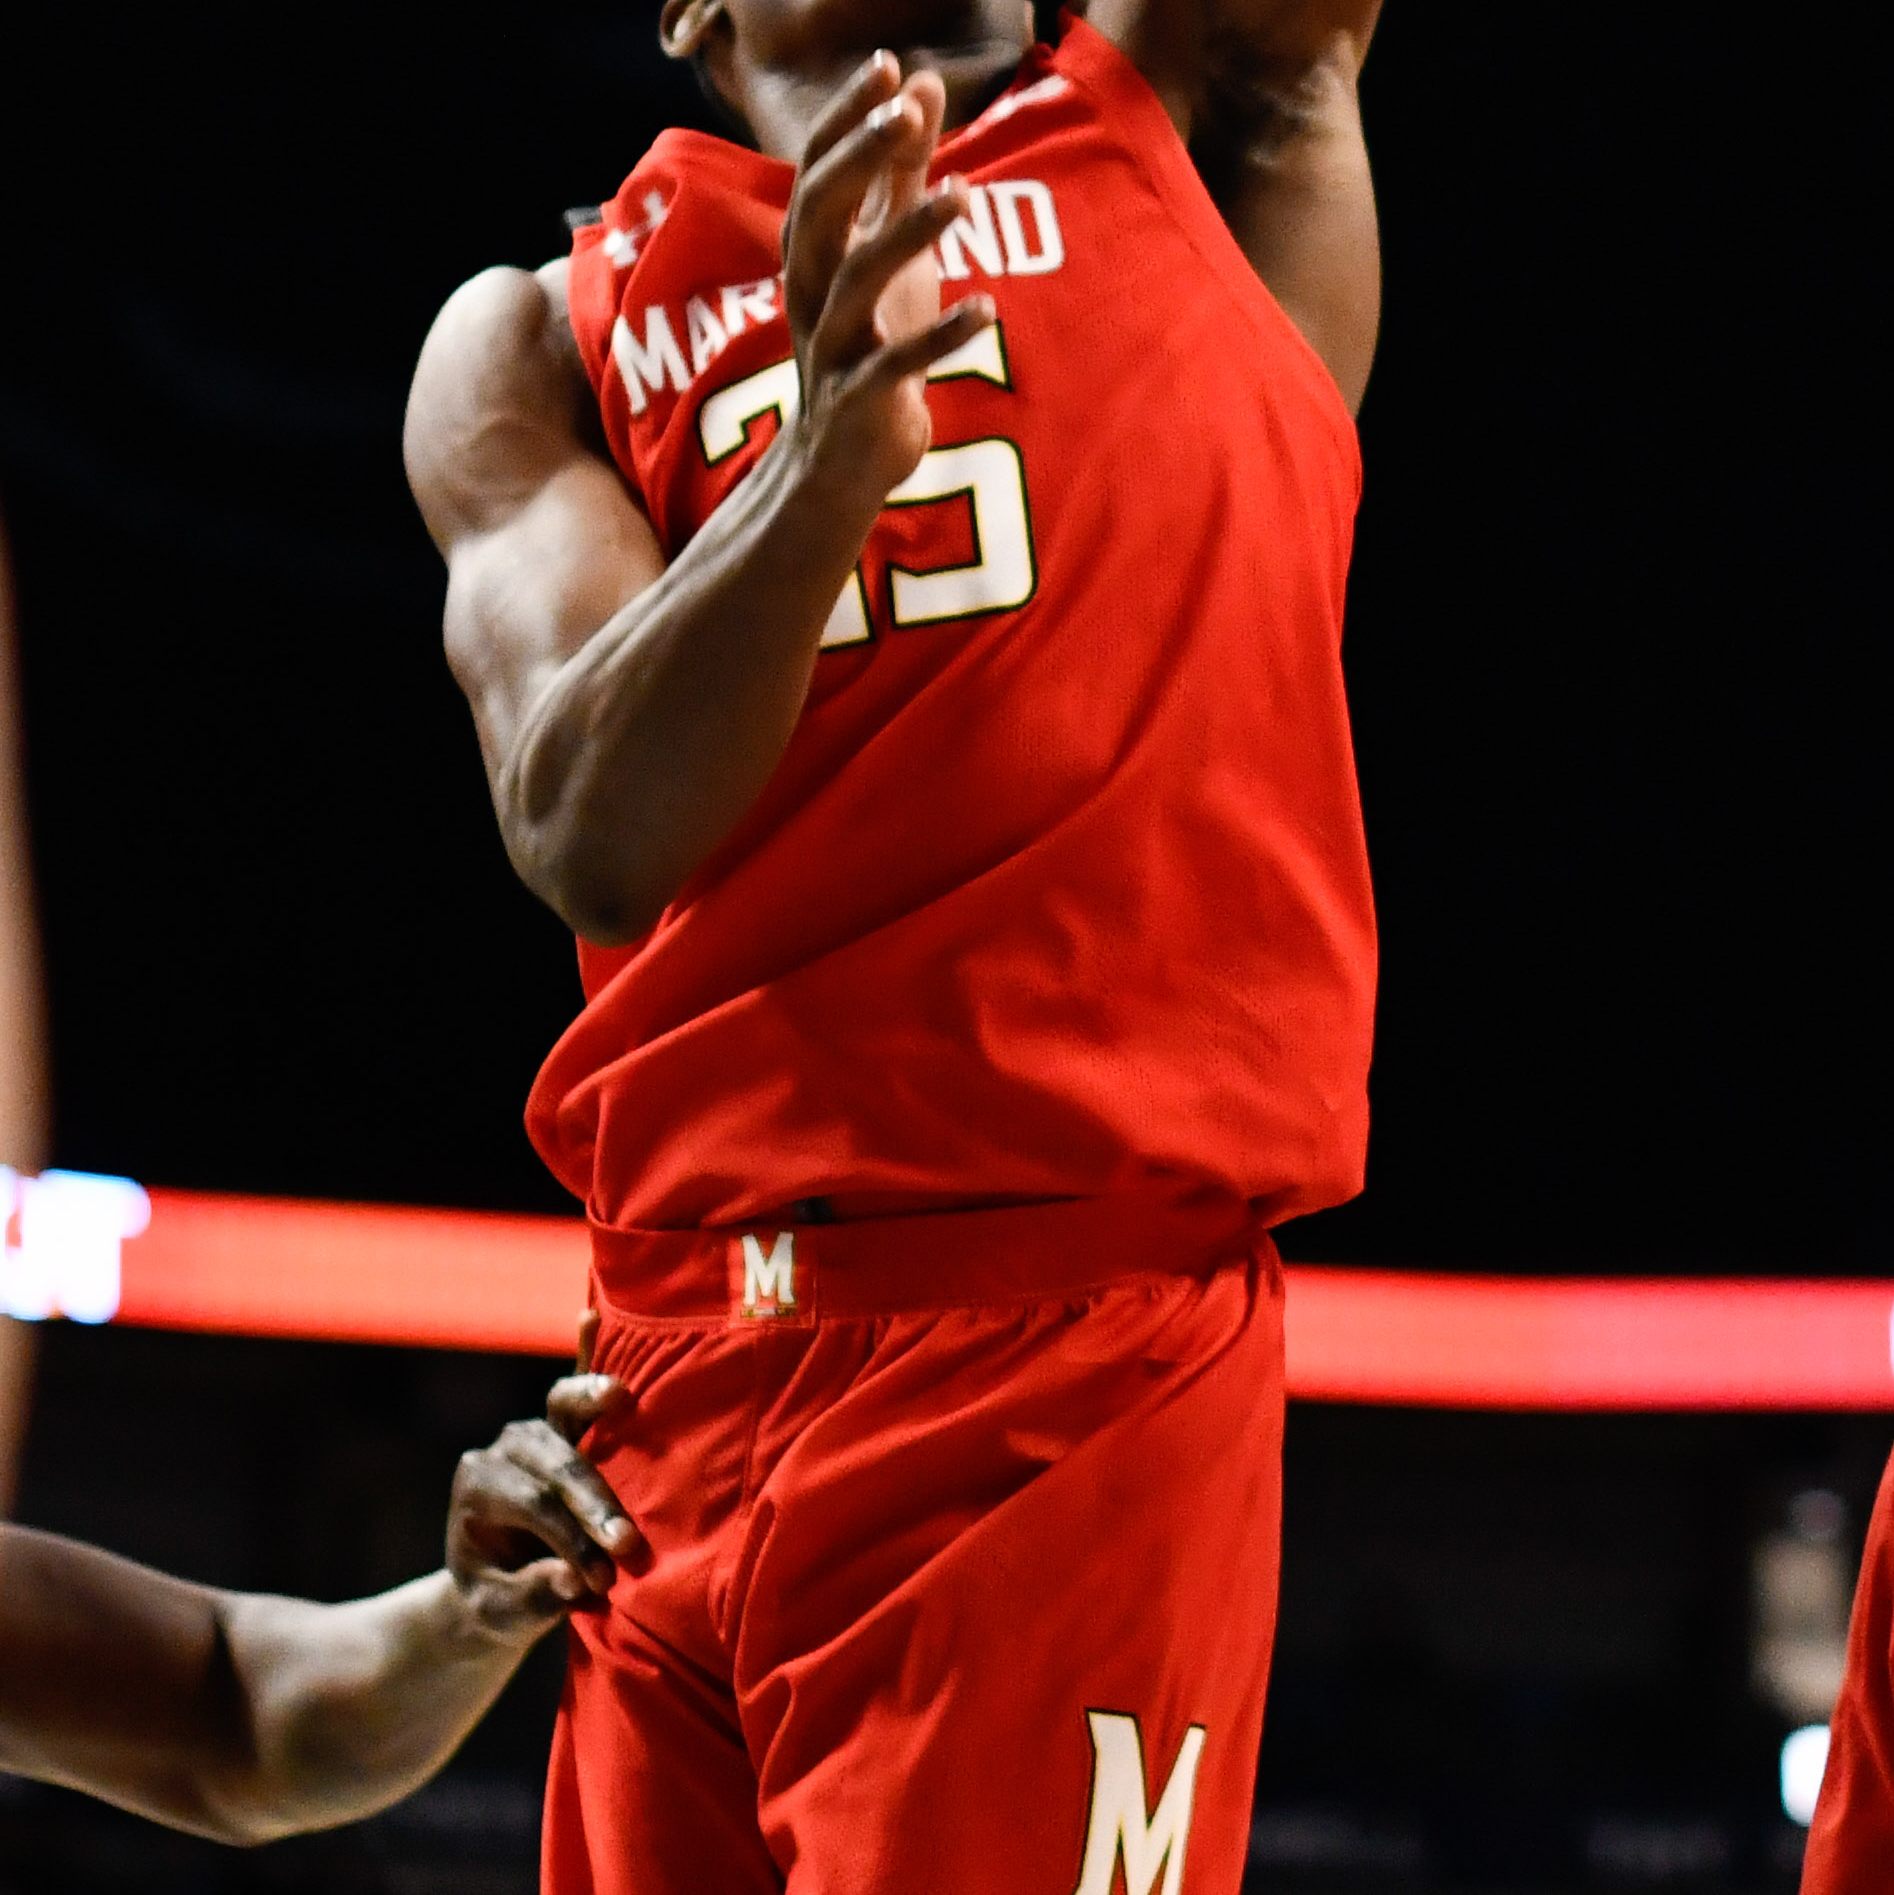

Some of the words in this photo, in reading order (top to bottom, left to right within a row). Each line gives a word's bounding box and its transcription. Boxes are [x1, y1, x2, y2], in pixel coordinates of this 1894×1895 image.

[612, 179, 1065, 416] MARND
[740, 1231, 797, 1307] M
[1070, 1707, 1207, 1895] M
